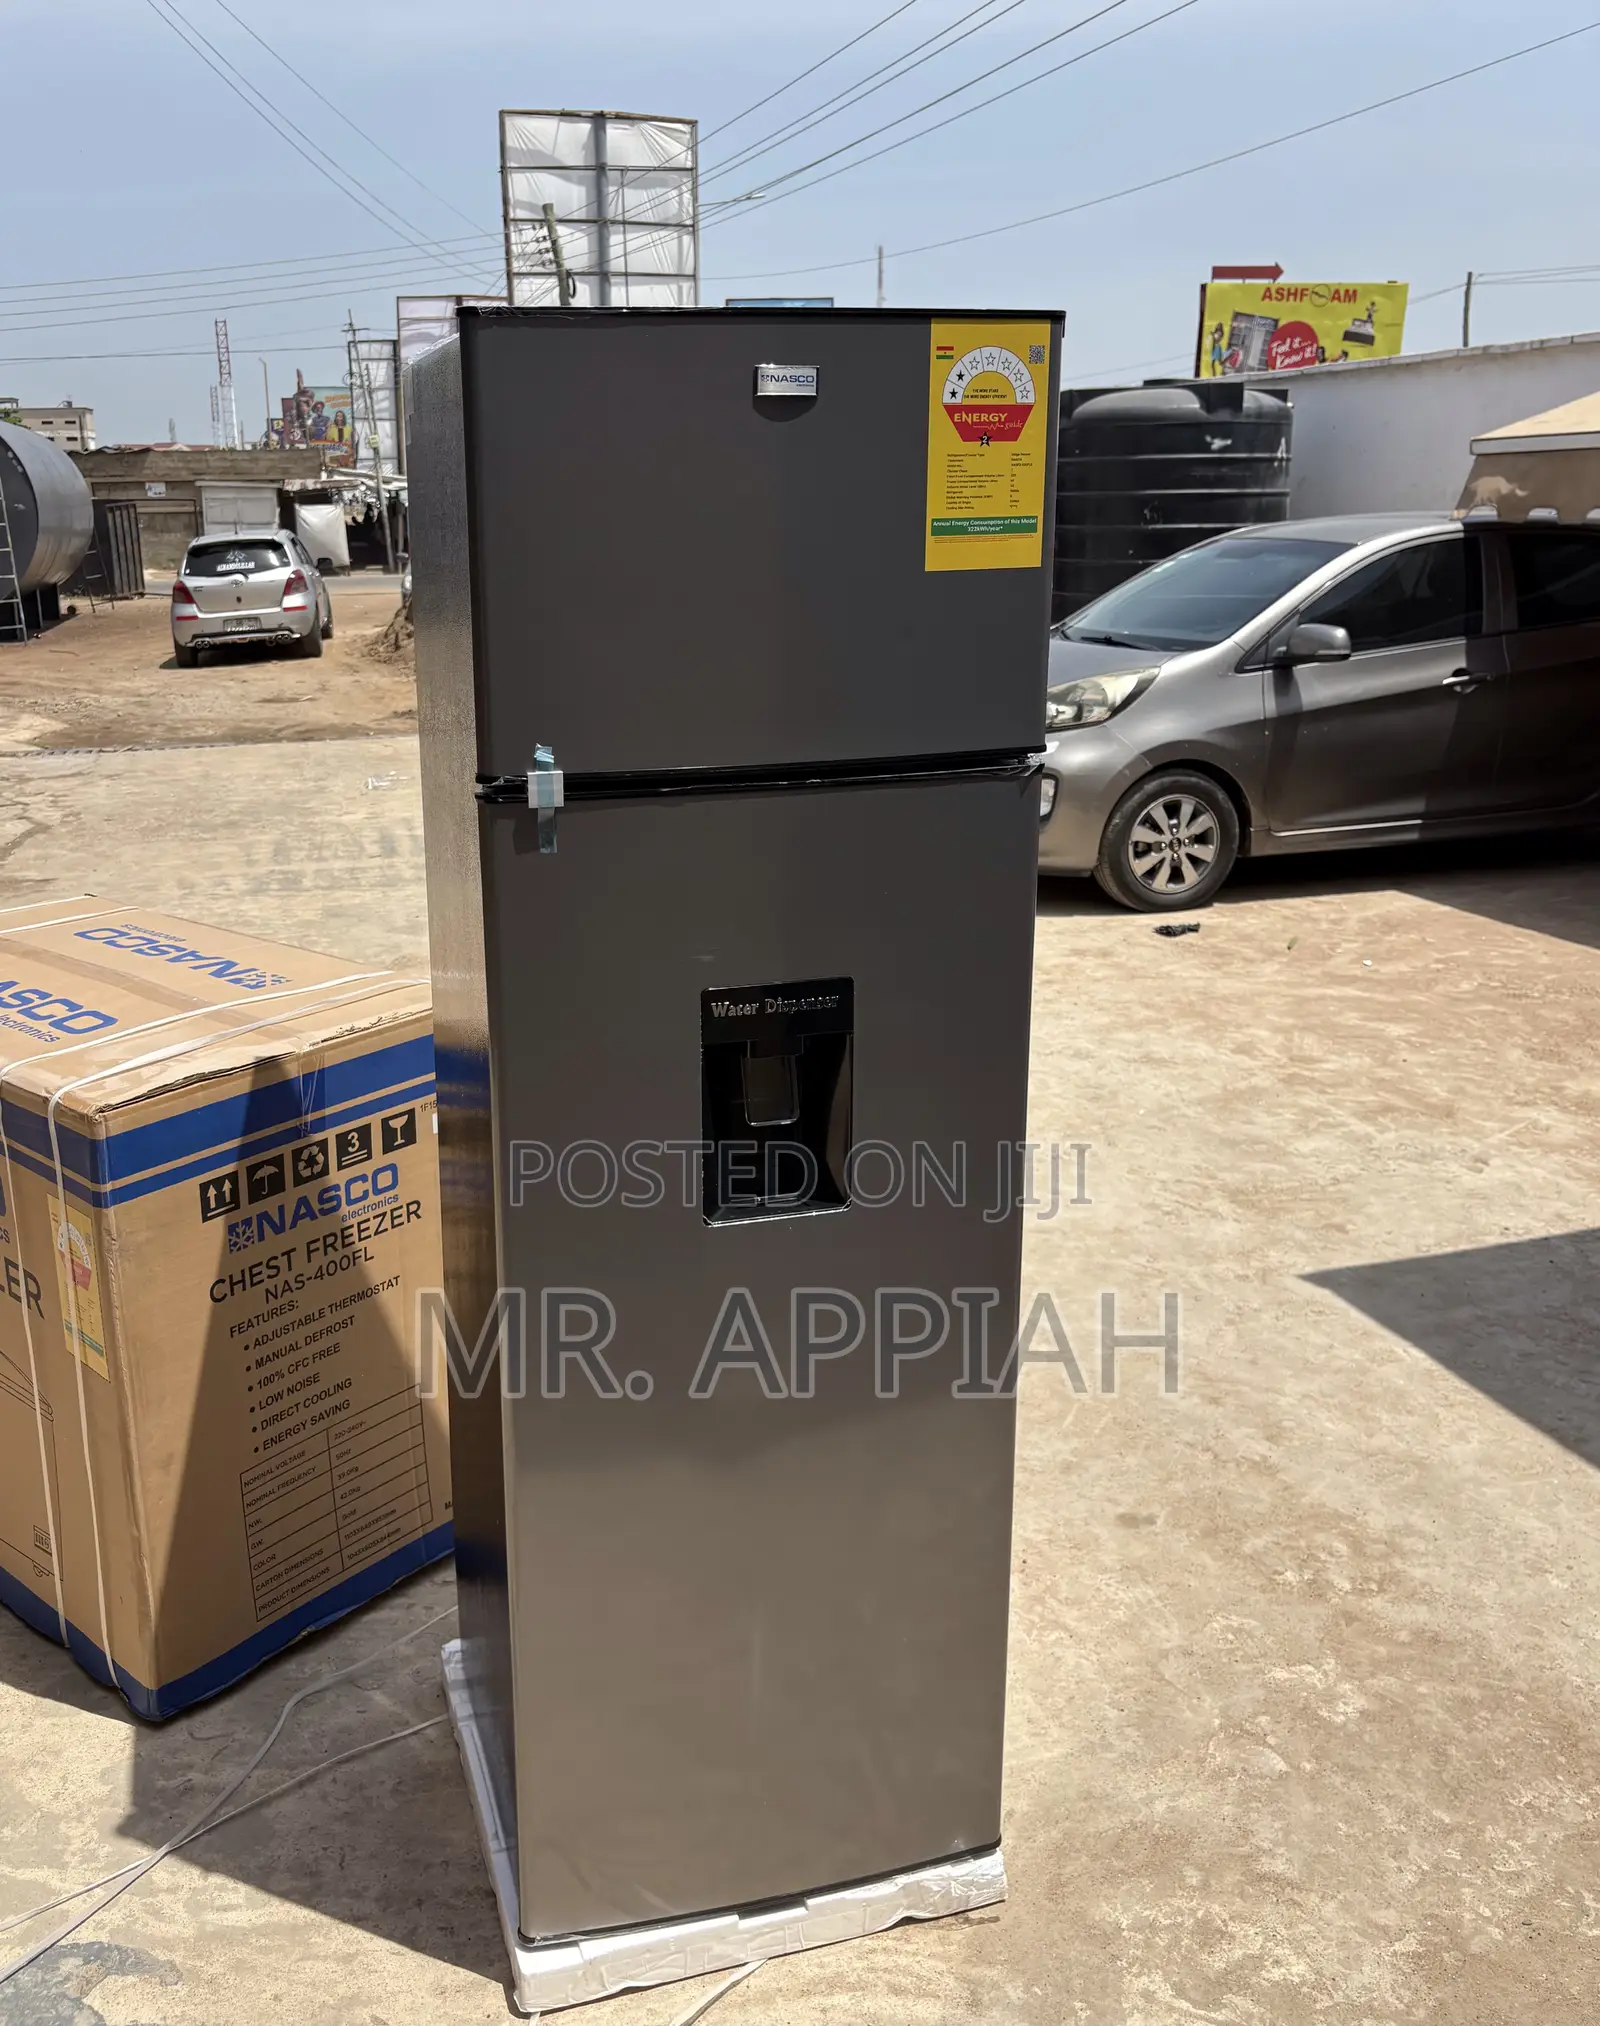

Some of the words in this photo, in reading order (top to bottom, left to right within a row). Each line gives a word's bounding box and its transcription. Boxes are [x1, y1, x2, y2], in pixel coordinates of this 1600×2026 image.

[770, 374, 815, 384] NASCO
[954, 411, 1008, 425] ENERGY
[982, 435, 988, 443] 2
[74, 927, 260, 979] NASCO
[711, 1000, 759, 1018] Water
[764, 996, 839, 1015] Dispenser
[347, 1131, 359, 1153] 3
[256, 1162, 399, 1243] NASCO
[341, 1193, 399, 1224] electronics
[209, 1247, 297, 1304] CHEST
[306, 1199, 422, 1264] FREEZER
[264, 1246, 375, 1304] NAS-400FL
[229, 1299, 300, 1339] FEATURES:
[253, 1307, 326, 1350] ADJUSTABLE
[328, 1275, 400, 1315] THERMOSTAT
[255, 1340, 303, 1370] MANUAL
[305, 1315, 356, 1347] DEFROST
[257, 1369, 286, 1390] 100%
[287, 1357, 310, 1376] CFC
[312, 1342, 341, 1364] FREE
[259, 1388, 284, 1411] LOW
[287, 1372, 321, 1398] NOISE
[260, 1401, 301, 1431] DIRECT
[303, 1377, 352, 1409] COOLING
[262, 1420, 309, 1451] ENERGY
[310, 1399, 351, 1427] SAVING
[244, 1465, 275, 1488] NOMINAL
[275, 1450, 306, 1470] VOLTAGE
[246, 1487, 277, 1508] NOMINAL
[277, 1465, 317, 1492] FREQUENCY
[252, 1552, 277, 1571] COLOR
[255, 1571, 284, 1593] CARTON
[284, 1548, 325, 1575] DIMENSIONS
[258, 1590, 290, 1614] PRODUCT
[290, 1566, 330, 1594] DIMENSIONS
